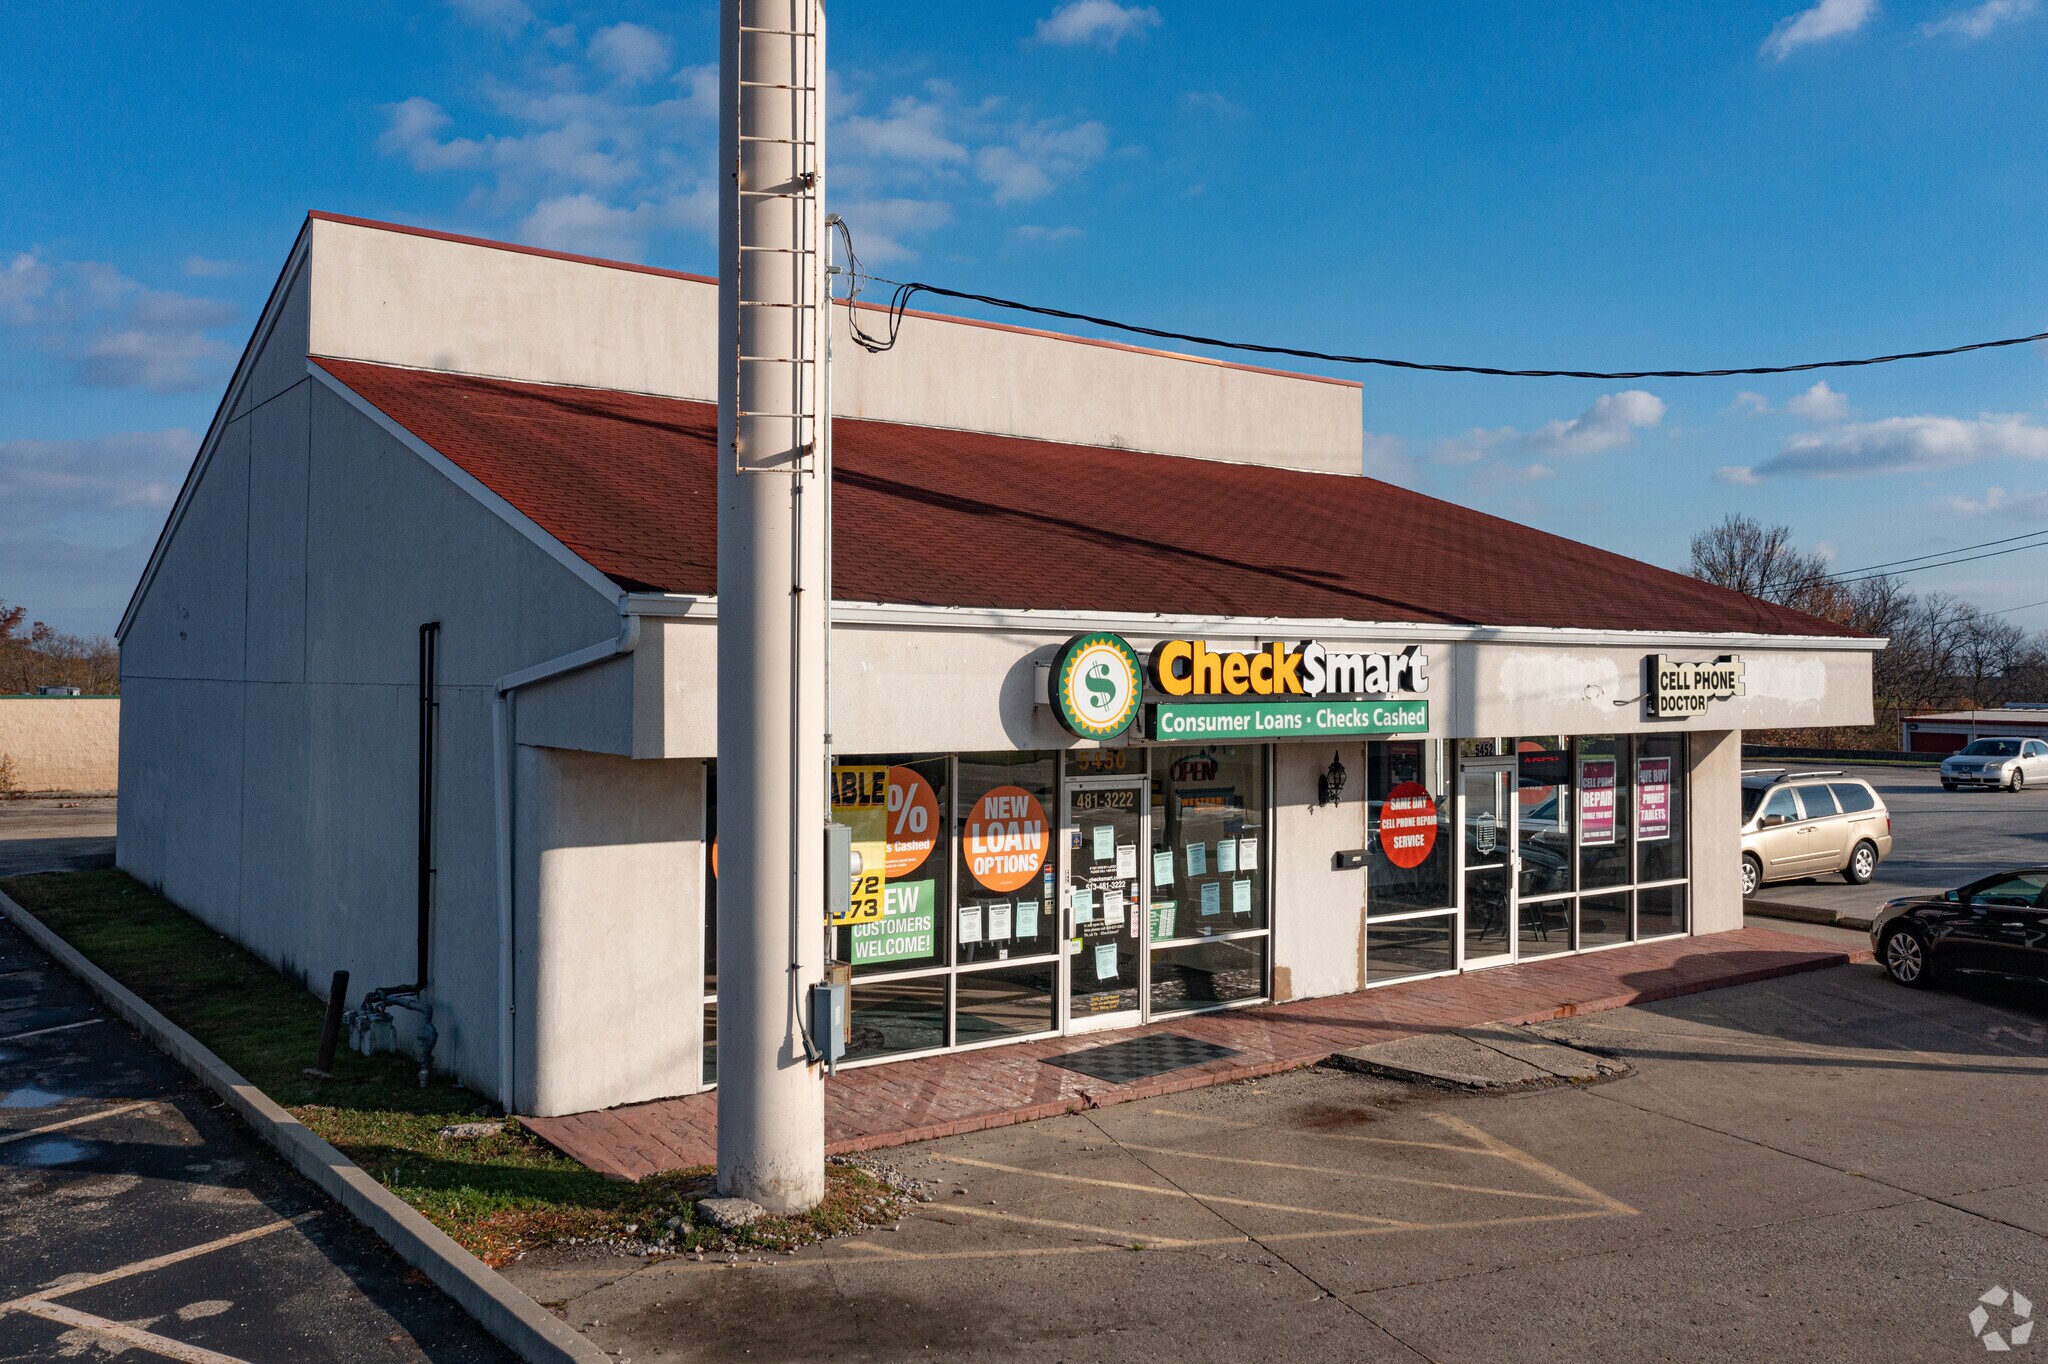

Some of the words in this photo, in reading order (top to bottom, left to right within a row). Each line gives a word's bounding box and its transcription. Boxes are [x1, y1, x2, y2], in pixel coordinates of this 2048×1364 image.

[1660, 671, 1691, 690] CELL
[1694, 671, 1736, 690] PHONE
[1660, 695, 1706, 711] DOCTOR
[1161, 711, 1251, 733] Consumer
[1255, 710, 1302, 730] Loans
[1316, 708, 1370, 728] Checks
[1373, 706, 1426, 727] Cashed
[1475, 743, 1494, 757] 5452
[1080, 751, 1127, 770] 5450
[1171, 761, 1216, 781] OPEN
[1653, 769, 1667, 783] BUY
[1583, 778, 1597, 788] CELL
[1077, 791, 1134, 809] 481-3222
[1181, 796, 1222, 807] WESTERN
[1390, 797, 1412, 811] SAME
[1412, 795, 1427, 809] DAY
[1583, 790, 1613, 807] REPAIR
[1643, 793, 1665, 804] PHONES
[984, 795, 1029, 819] NEW
[1641, 808, 1666, 821] TABLETS
[1382, 819, 1396, 829] CELL
[1396, 816, 1416, 829] PHONE
[1416, 815, 1438, 827] REPAIR
[971, 820, 1041, 854] LOAN
[1393, 833, 1425, 849] SERVICE
[894, 838, 930, 853] Cashed
[973, 853, 1039, 876] OPTIONS
[1086, 880, 1126, 891] 513-481-3222
[884, 886, 919, 916] EW
[854, 916, 931, 938] CUSTOMERS
[855, 935, 930, 958] WELCOME!
